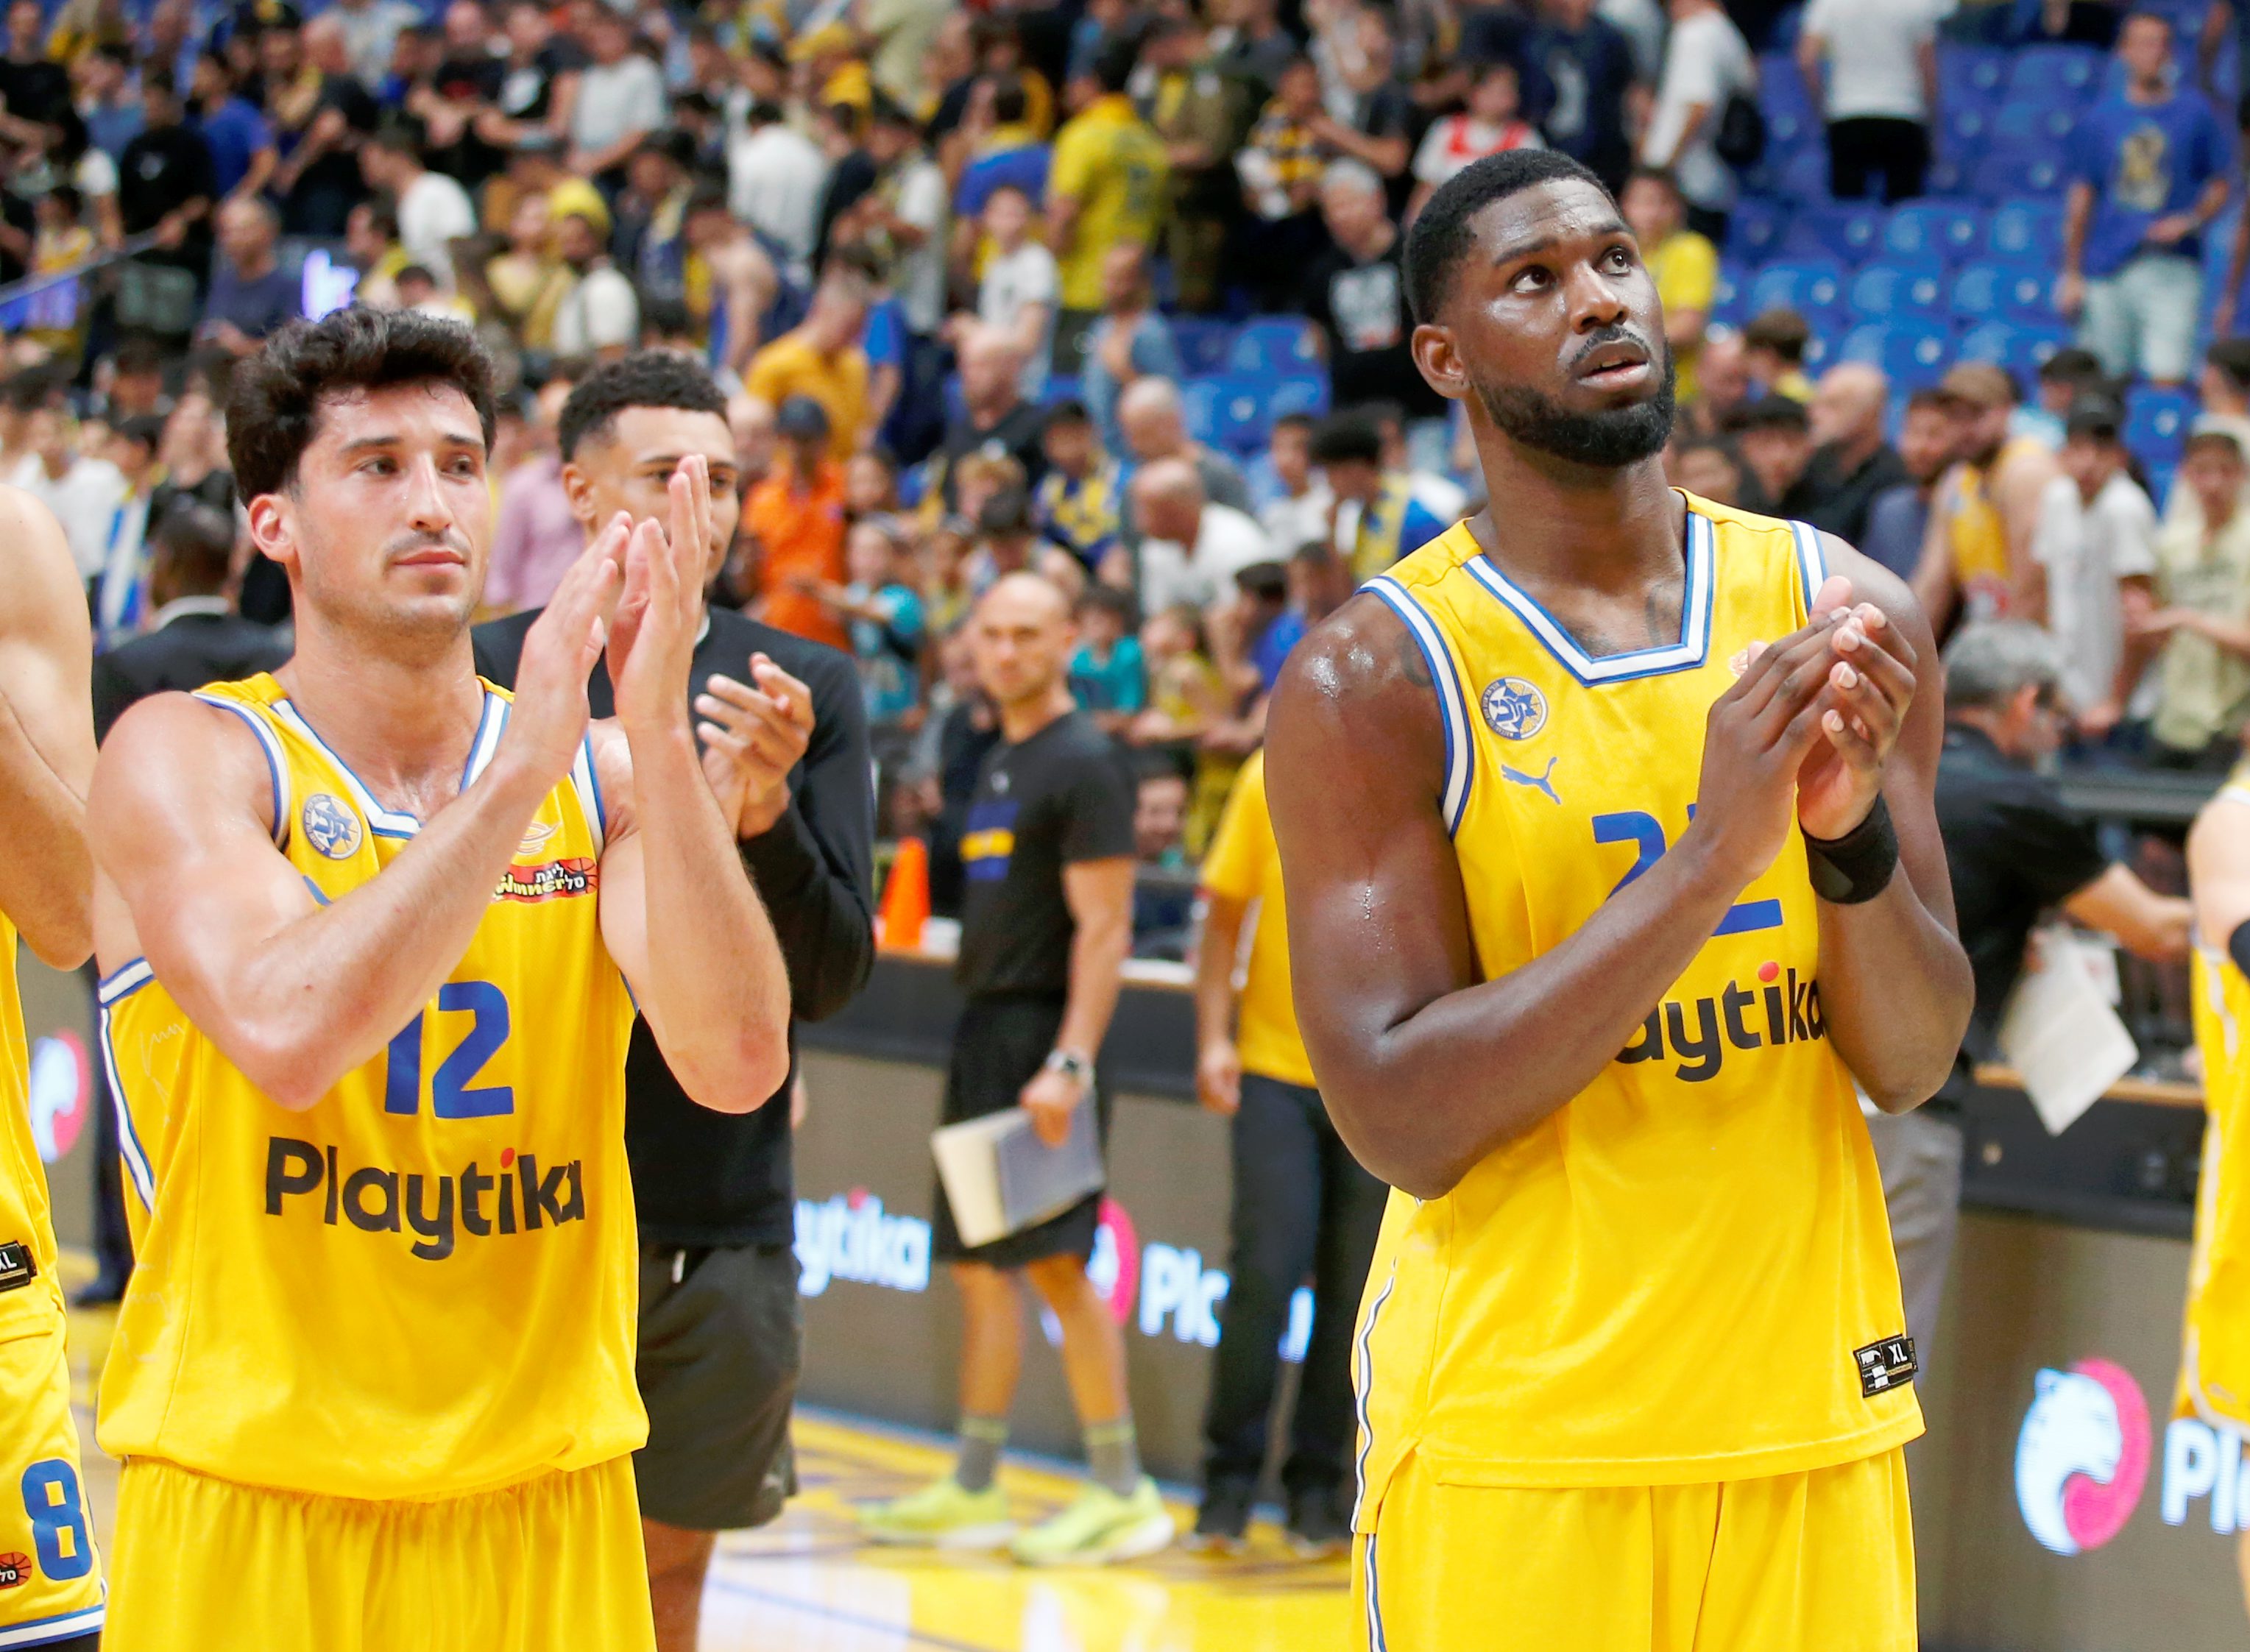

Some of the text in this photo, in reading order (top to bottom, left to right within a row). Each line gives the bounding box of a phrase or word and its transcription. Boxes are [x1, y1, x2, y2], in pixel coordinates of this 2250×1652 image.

[535, 862, 565, 883] ליגת
[385, 981, 514, 1119] 12
[1615, 961, 1827, 1082] aytika
[266, 1136, 585, 1261] Playtika
[792, 1186, 933, 1298] ytika
[1888, 1342, 1908, 1365] XL
[21, 1458, 93, 1581] 8
